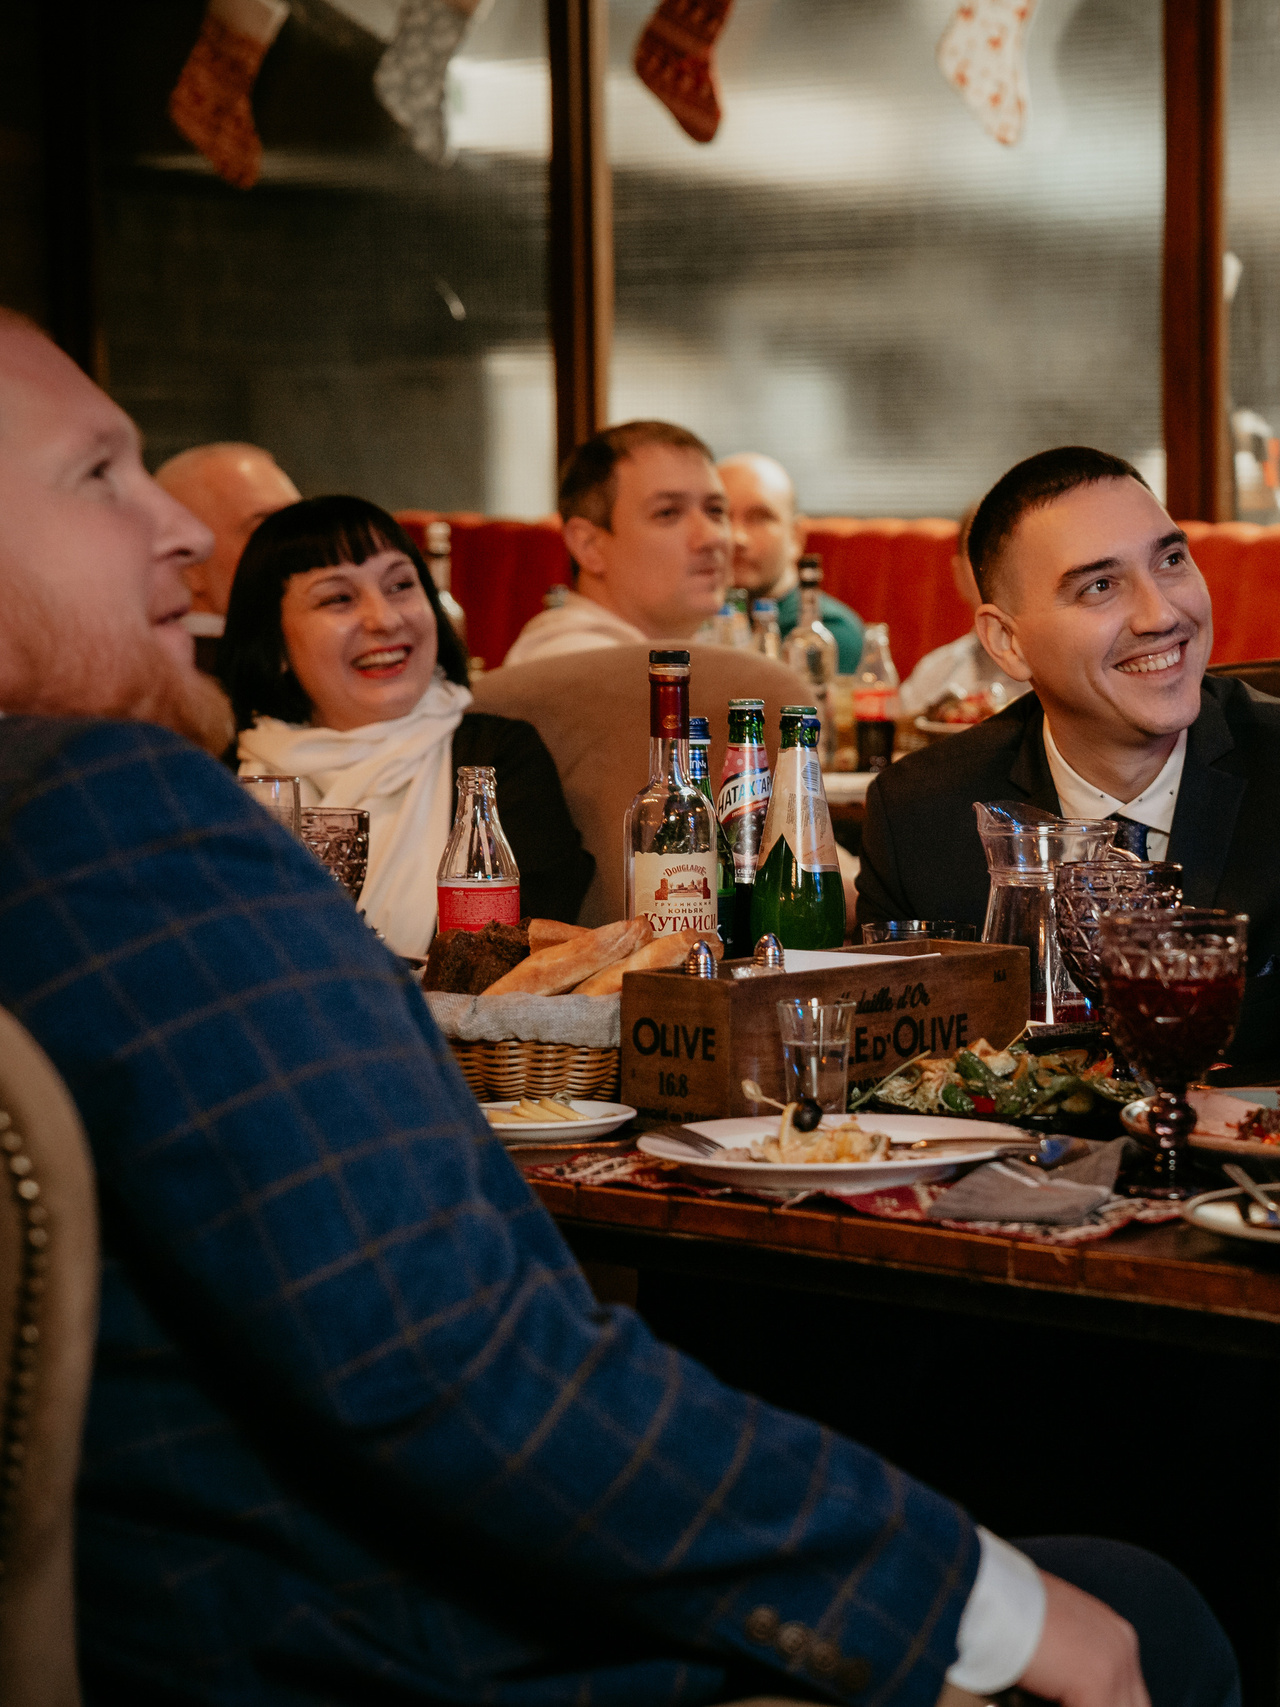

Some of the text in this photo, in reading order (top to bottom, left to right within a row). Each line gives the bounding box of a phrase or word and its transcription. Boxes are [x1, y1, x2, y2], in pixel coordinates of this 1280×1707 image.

[718, 774, 772, 816] НАТАХТАР
[632, 1017, 716, 1062] OLIVE
[658, 1071, 689, 1099] 16.8
